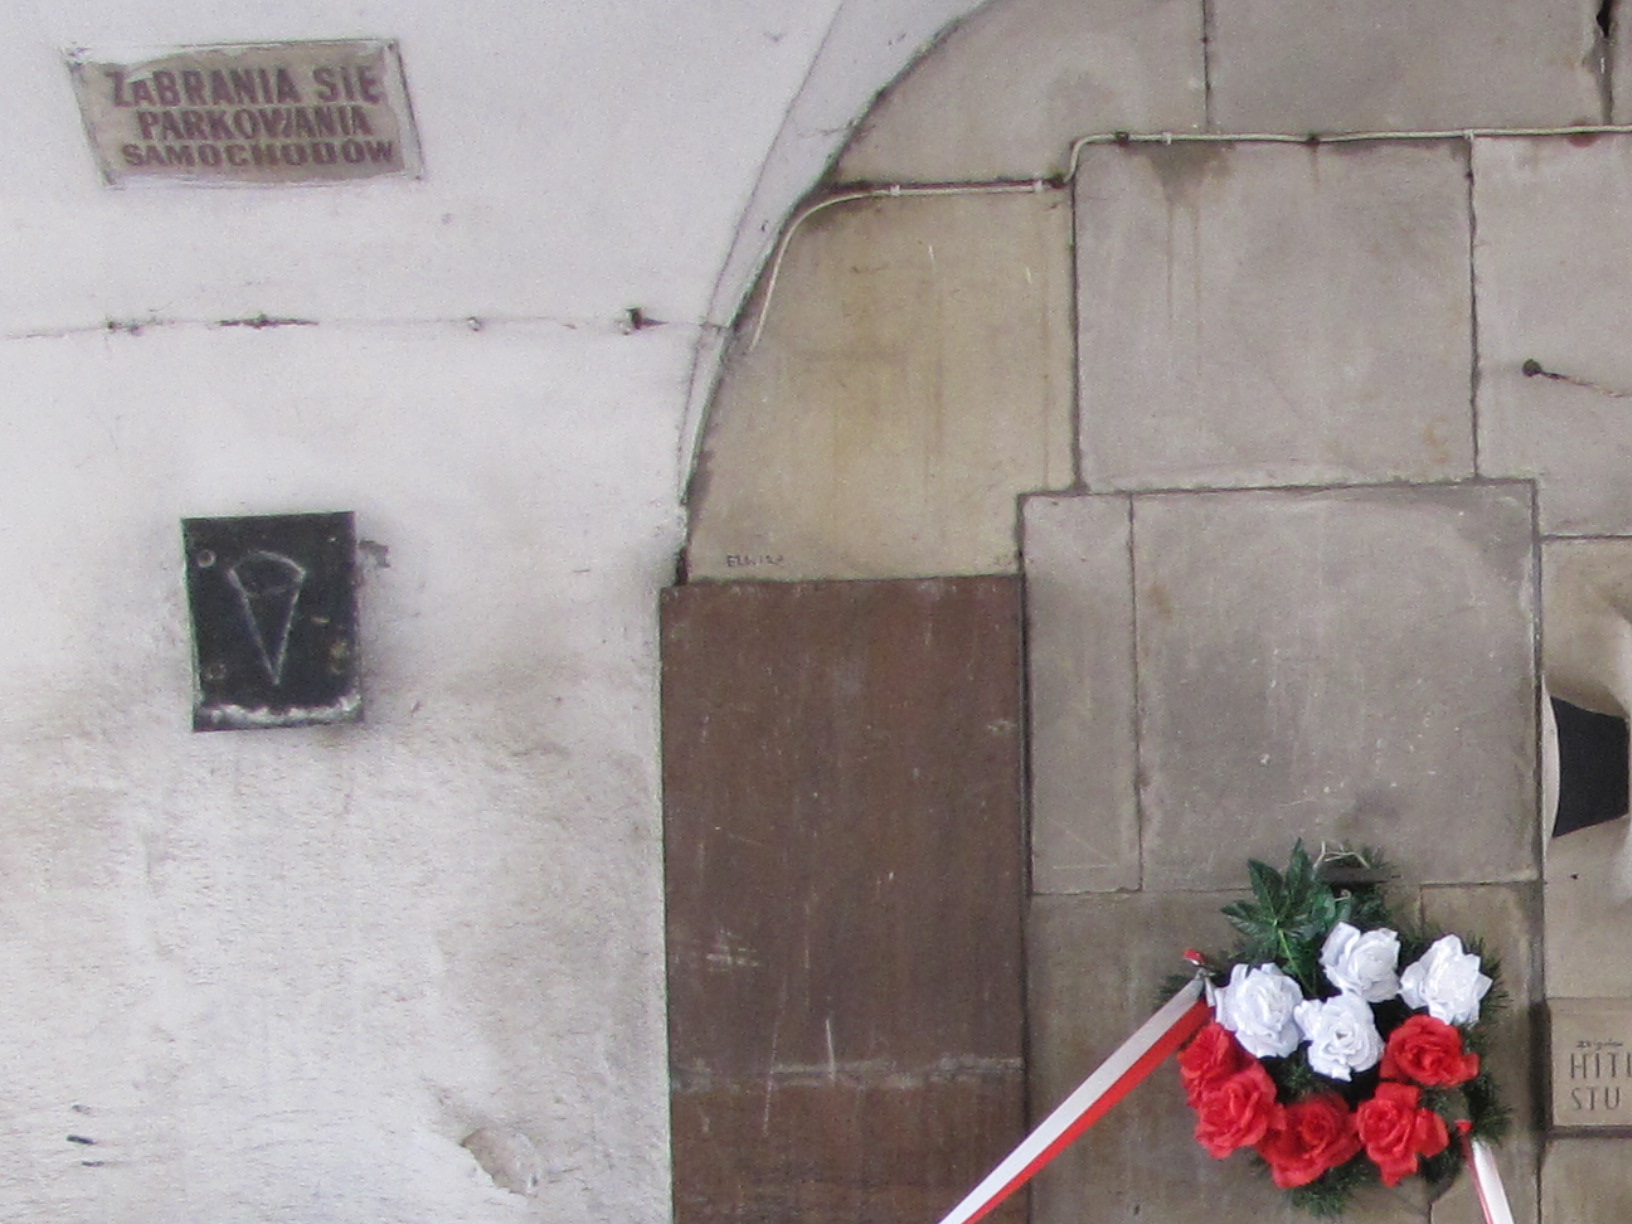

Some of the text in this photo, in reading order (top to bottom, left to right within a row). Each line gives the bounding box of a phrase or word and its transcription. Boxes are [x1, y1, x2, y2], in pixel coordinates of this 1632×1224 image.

[104, 66, 302, 107] ZABRANIA
[137, 105, 374, 140] PARKOWANIA
[1570, 1085, 1621, 1112] STU
